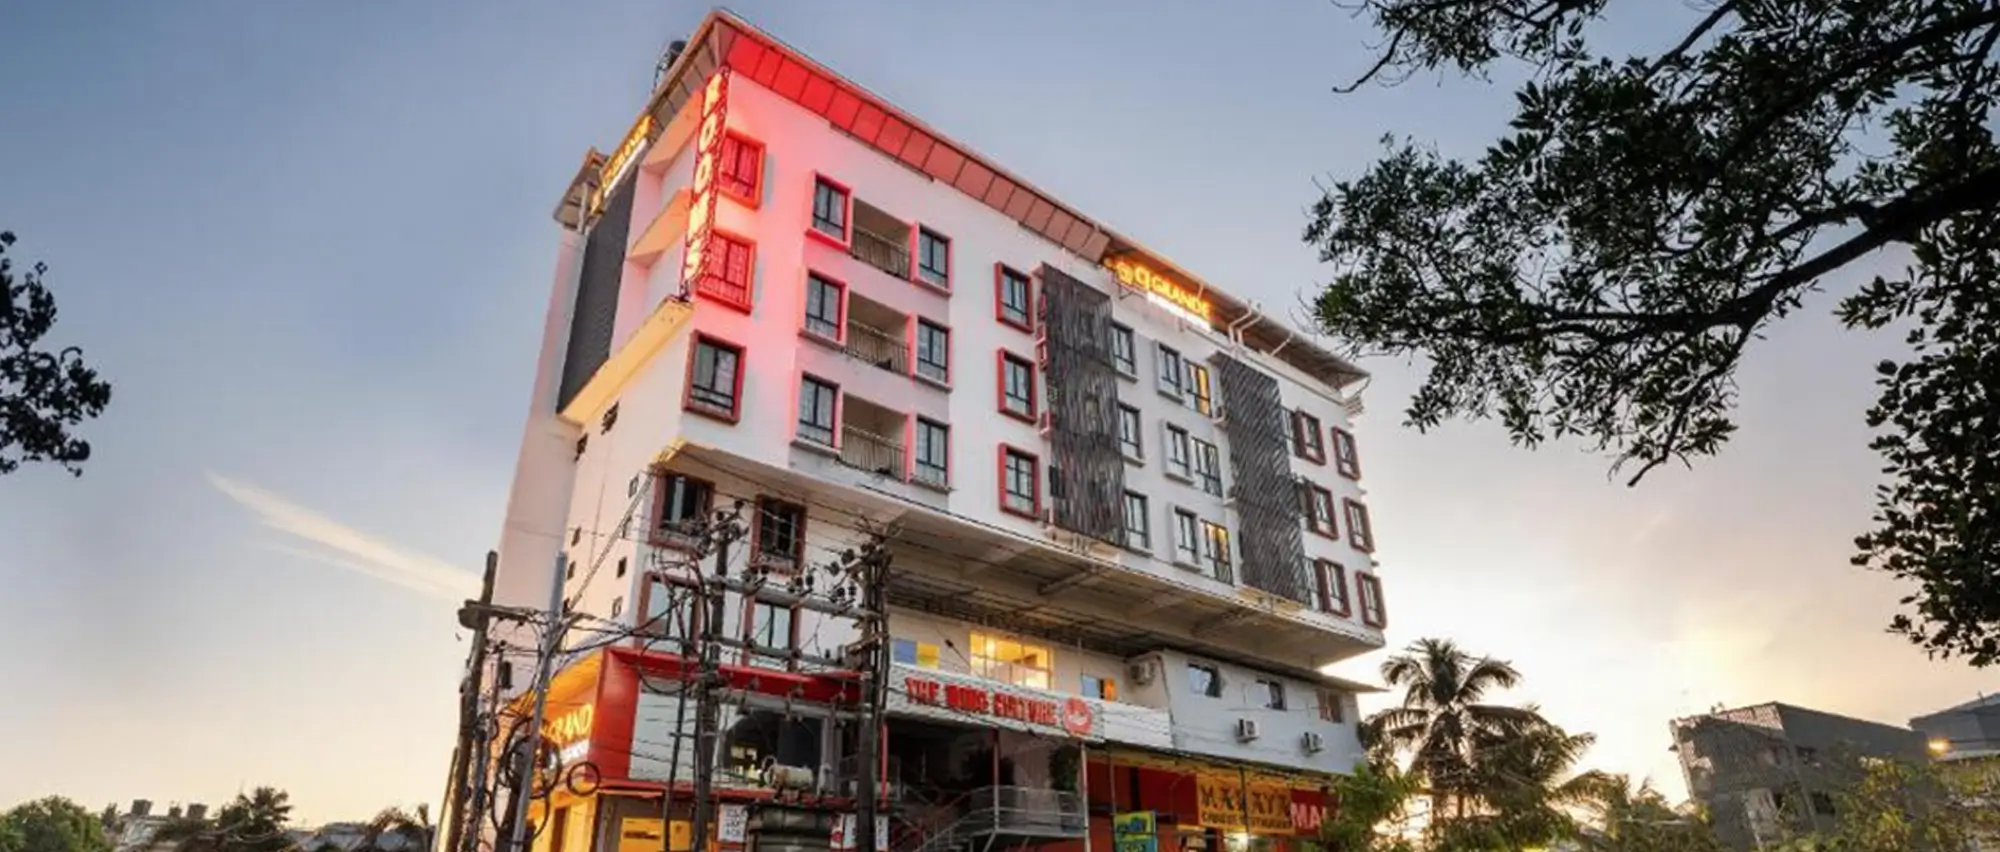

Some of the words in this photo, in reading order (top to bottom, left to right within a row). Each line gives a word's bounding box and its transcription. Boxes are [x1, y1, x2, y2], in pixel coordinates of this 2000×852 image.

[683, 72, 724, 281] ROOMS
[1151, 275, 1211, 320] GRANDE
[905, 677, 940, 703] THE
